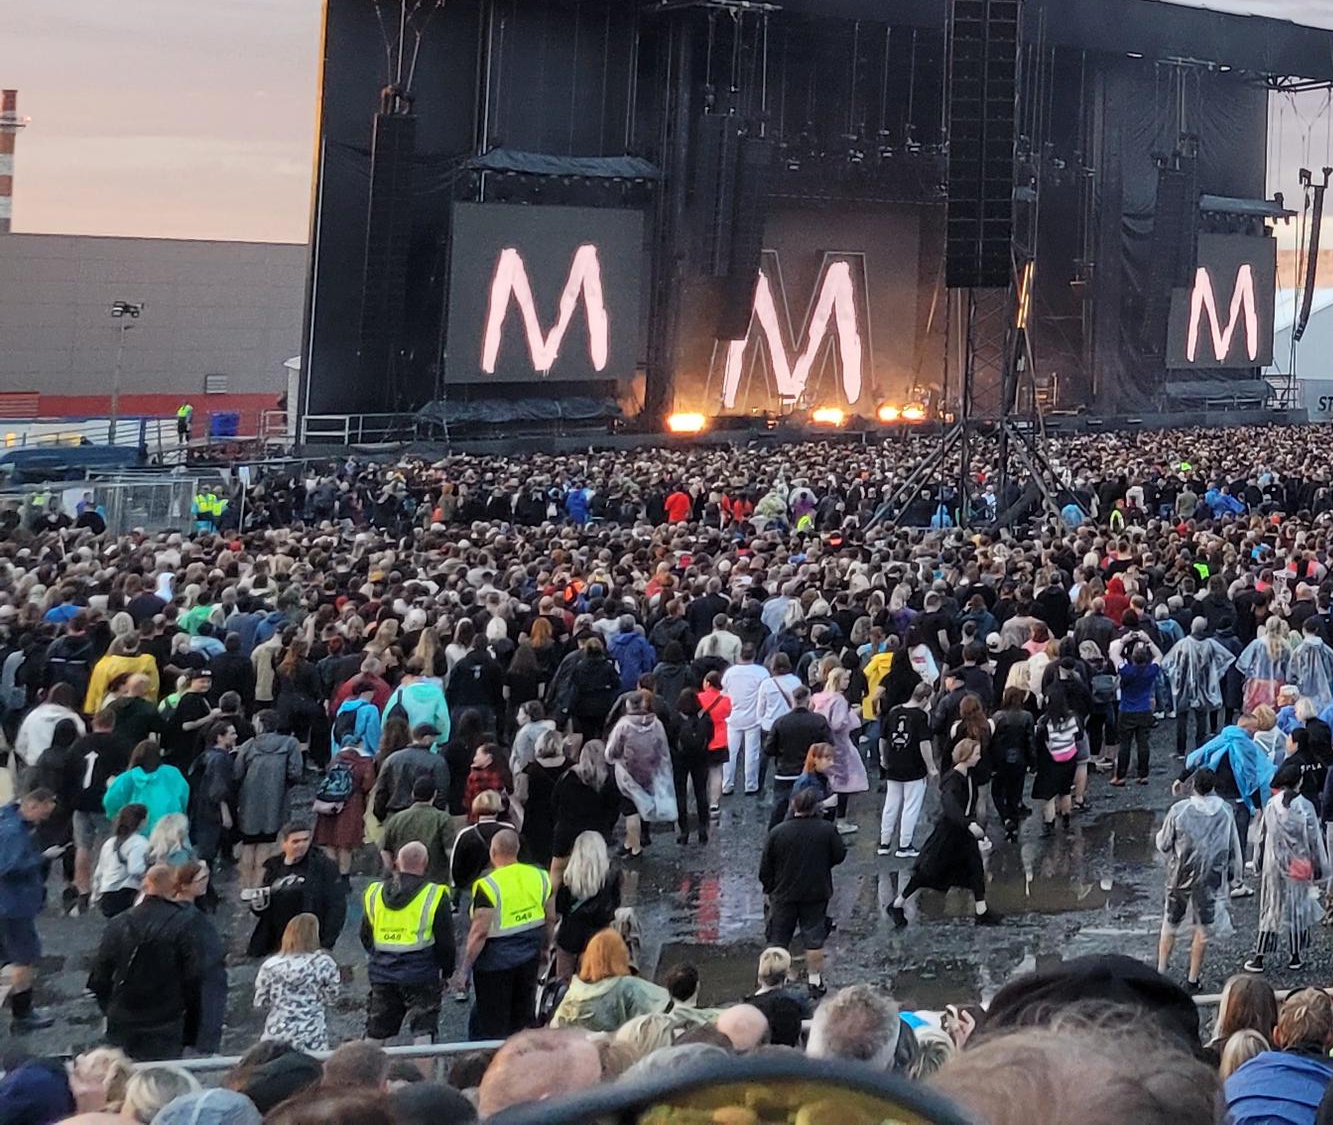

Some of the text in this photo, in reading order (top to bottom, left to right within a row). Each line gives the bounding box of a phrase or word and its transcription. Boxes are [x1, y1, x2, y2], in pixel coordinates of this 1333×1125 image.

[482, 244, 608, 375] M
[723, 261, 862, 409] M
[1187, 263, 1258, 363] M
